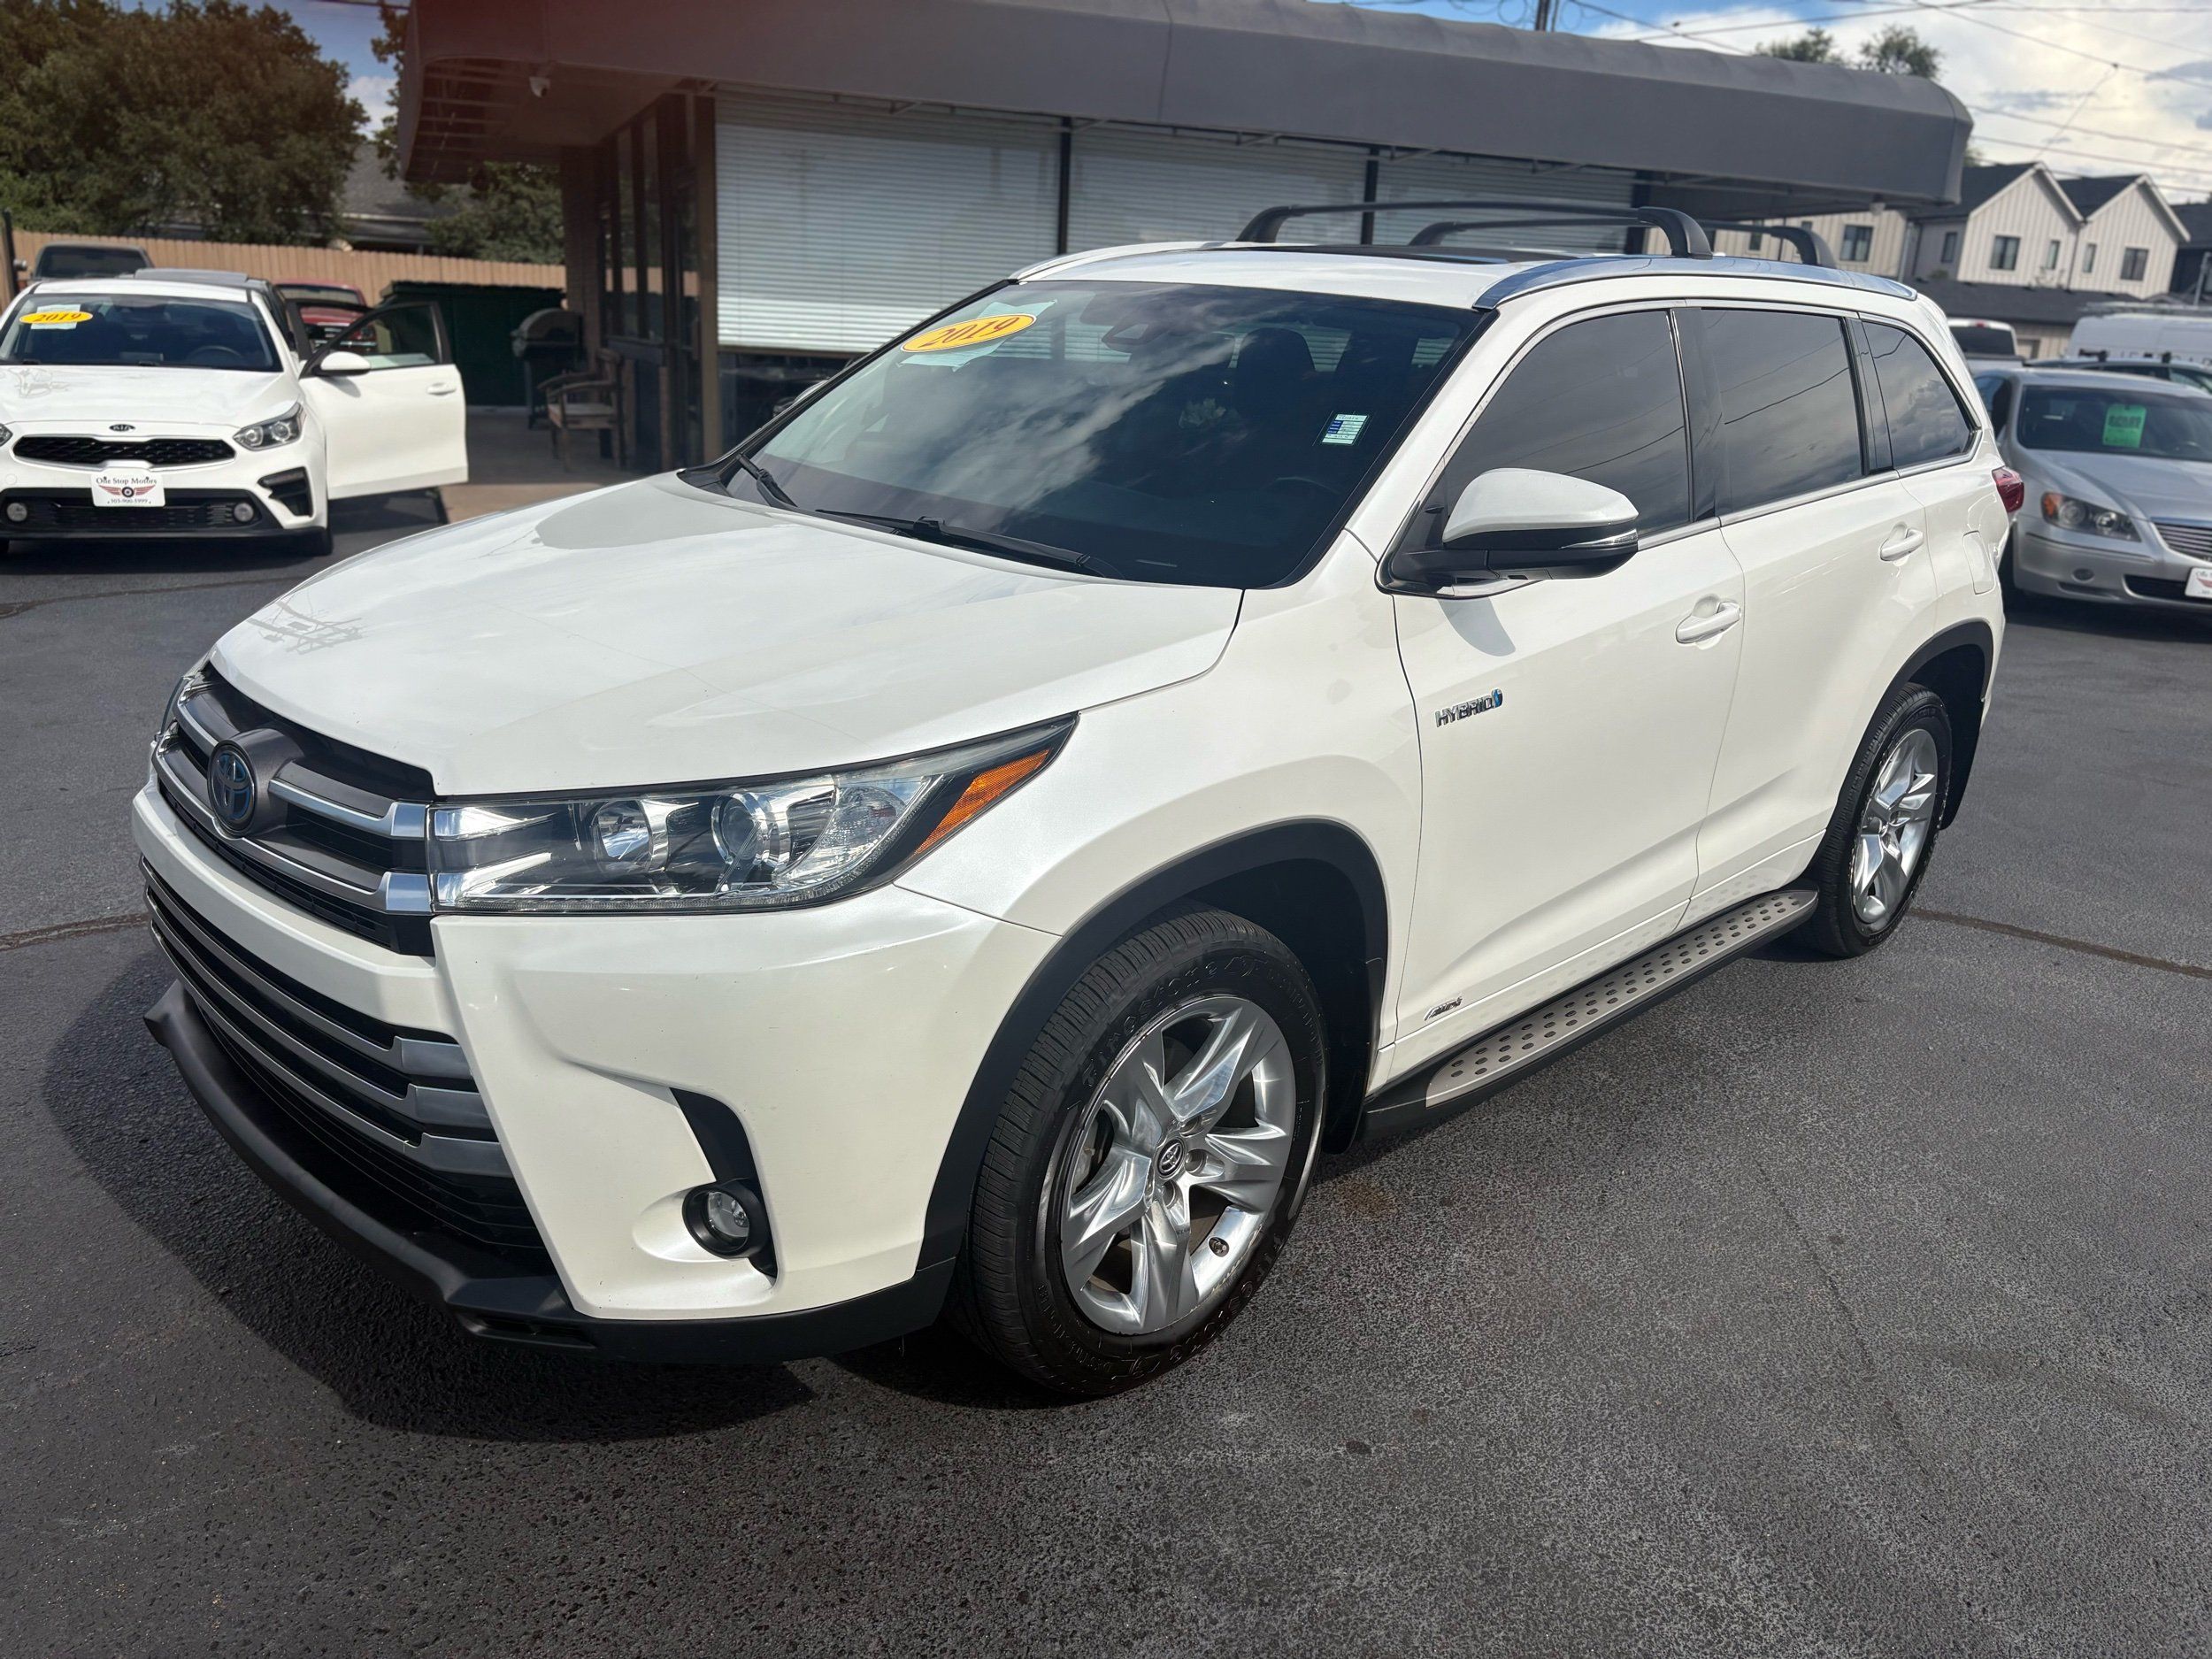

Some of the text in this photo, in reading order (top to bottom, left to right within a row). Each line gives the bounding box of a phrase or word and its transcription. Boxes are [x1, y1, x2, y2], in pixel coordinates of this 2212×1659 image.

[33, 312, 81, 322] 2019
[918, 317, 1020, 349] 2019
[1435, 695, 1494, 727] HYBRID
